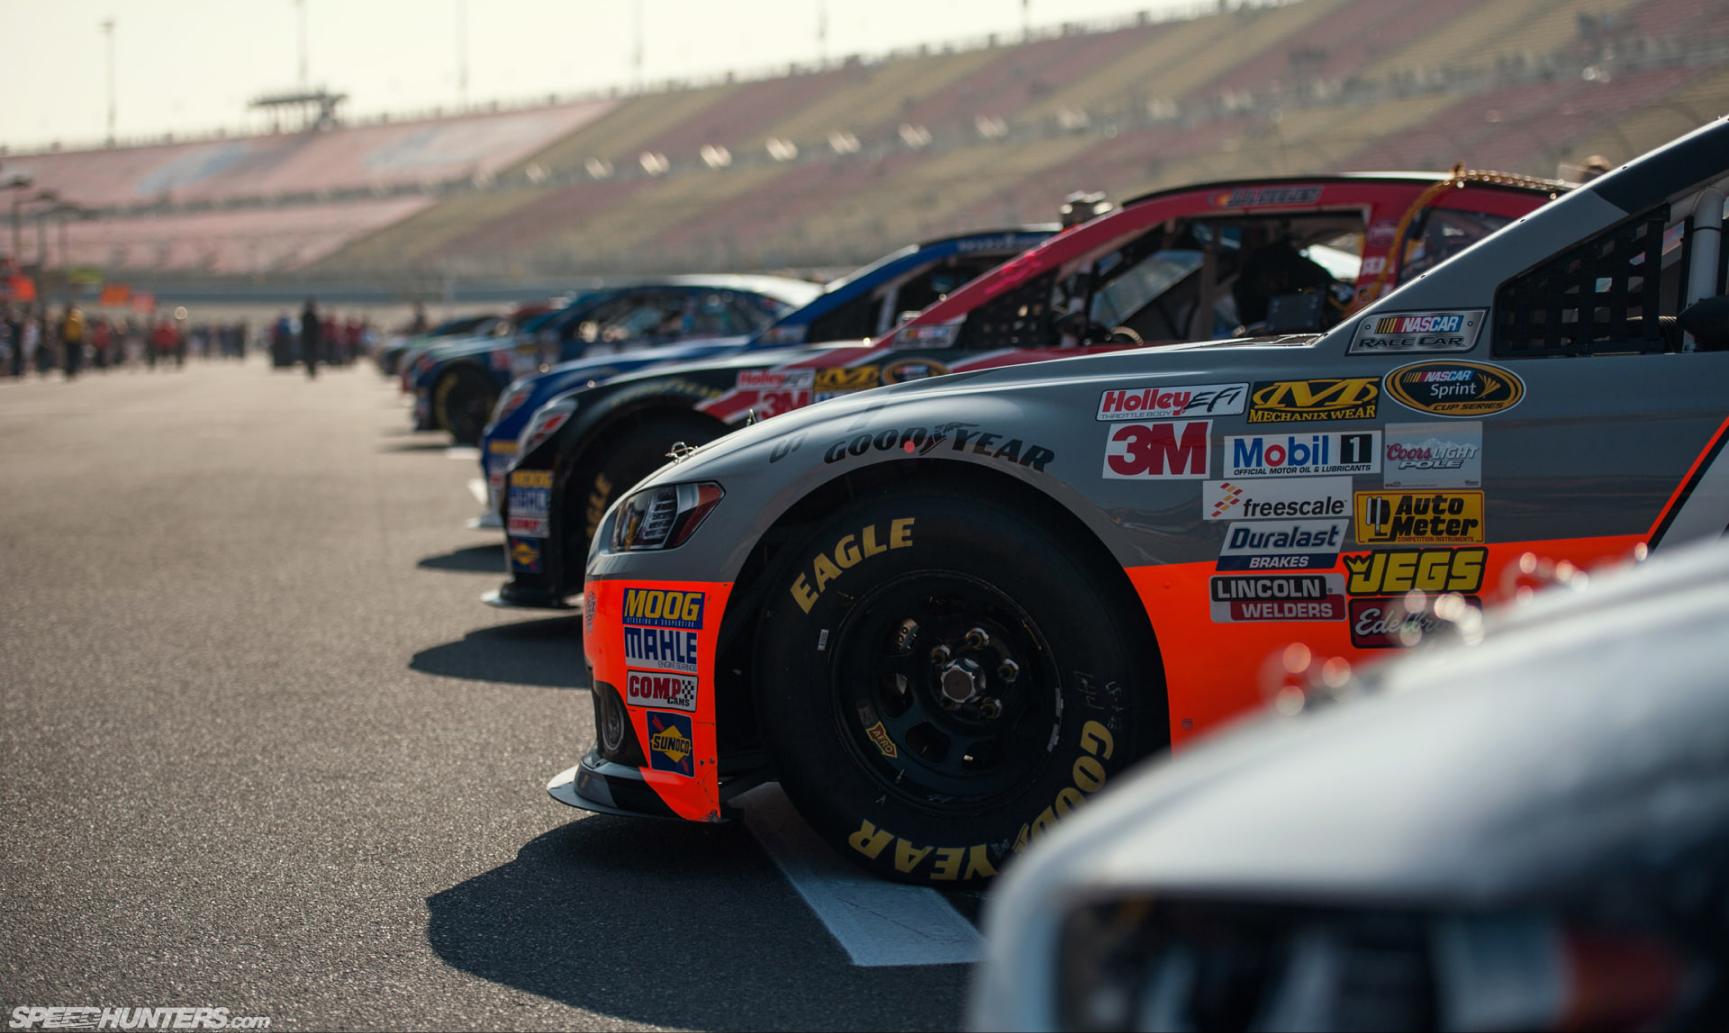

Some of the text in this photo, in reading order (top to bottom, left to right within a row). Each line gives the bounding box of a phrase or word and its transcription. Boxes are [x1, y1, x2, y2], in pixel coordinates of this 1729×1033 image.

[1402, 316, 1459, 332] NASCAR
[1359, 336, 1466, 348] RACE CAR
[1425, 371, 1472, 382] NASCAR
[1430, 382, 1477, 399] Sprint
[1102, 387, 1243, 416] Holley EFI
[1433, 402, 1504, 411] CUP SERIES
[1249, 405, 1376, 423] MECHANIX WEAR
[1107, 422, 1208, 476] 3M
[1233, 434, 1360, 468] Mobil 1
[1387, 443, 1478, 460] Coors LIGHT
[1233, 467, 1267, 475] OFFICIAL
[1269, 466, 1298, 474] MOTOR
[1299, 465, 1311, 473] OIL
[1321, 464, 1371, 473] LUBRICANTS
[1398, 459, 1464, 470] POLE
[1244, 497, 1344, 516] freescale
[1394, 495, 1465, 515] Auto
[1391, 515, 1479, 536] Meter
[1228, 526, 1338, 549] Duralast
[789, 517, 916, 614] EAGLE
[1249, 556, 1309, 568] BRAKES
[1350, 549, 1484, 594] JEGS
[1217, 579, 1320, 599] LINCOLN
[624, 590, 702, 621] MOOG
[1242, 603, 1333, 618] WELDERS
[624, 628, 697, 664] MAHLE
[629, 675, 681, 699] COMP
[667, 697, 690, 707] CAMS
[653, 735, 690, 754] SUNOCO
[869, 729, 894, 753] AERO
